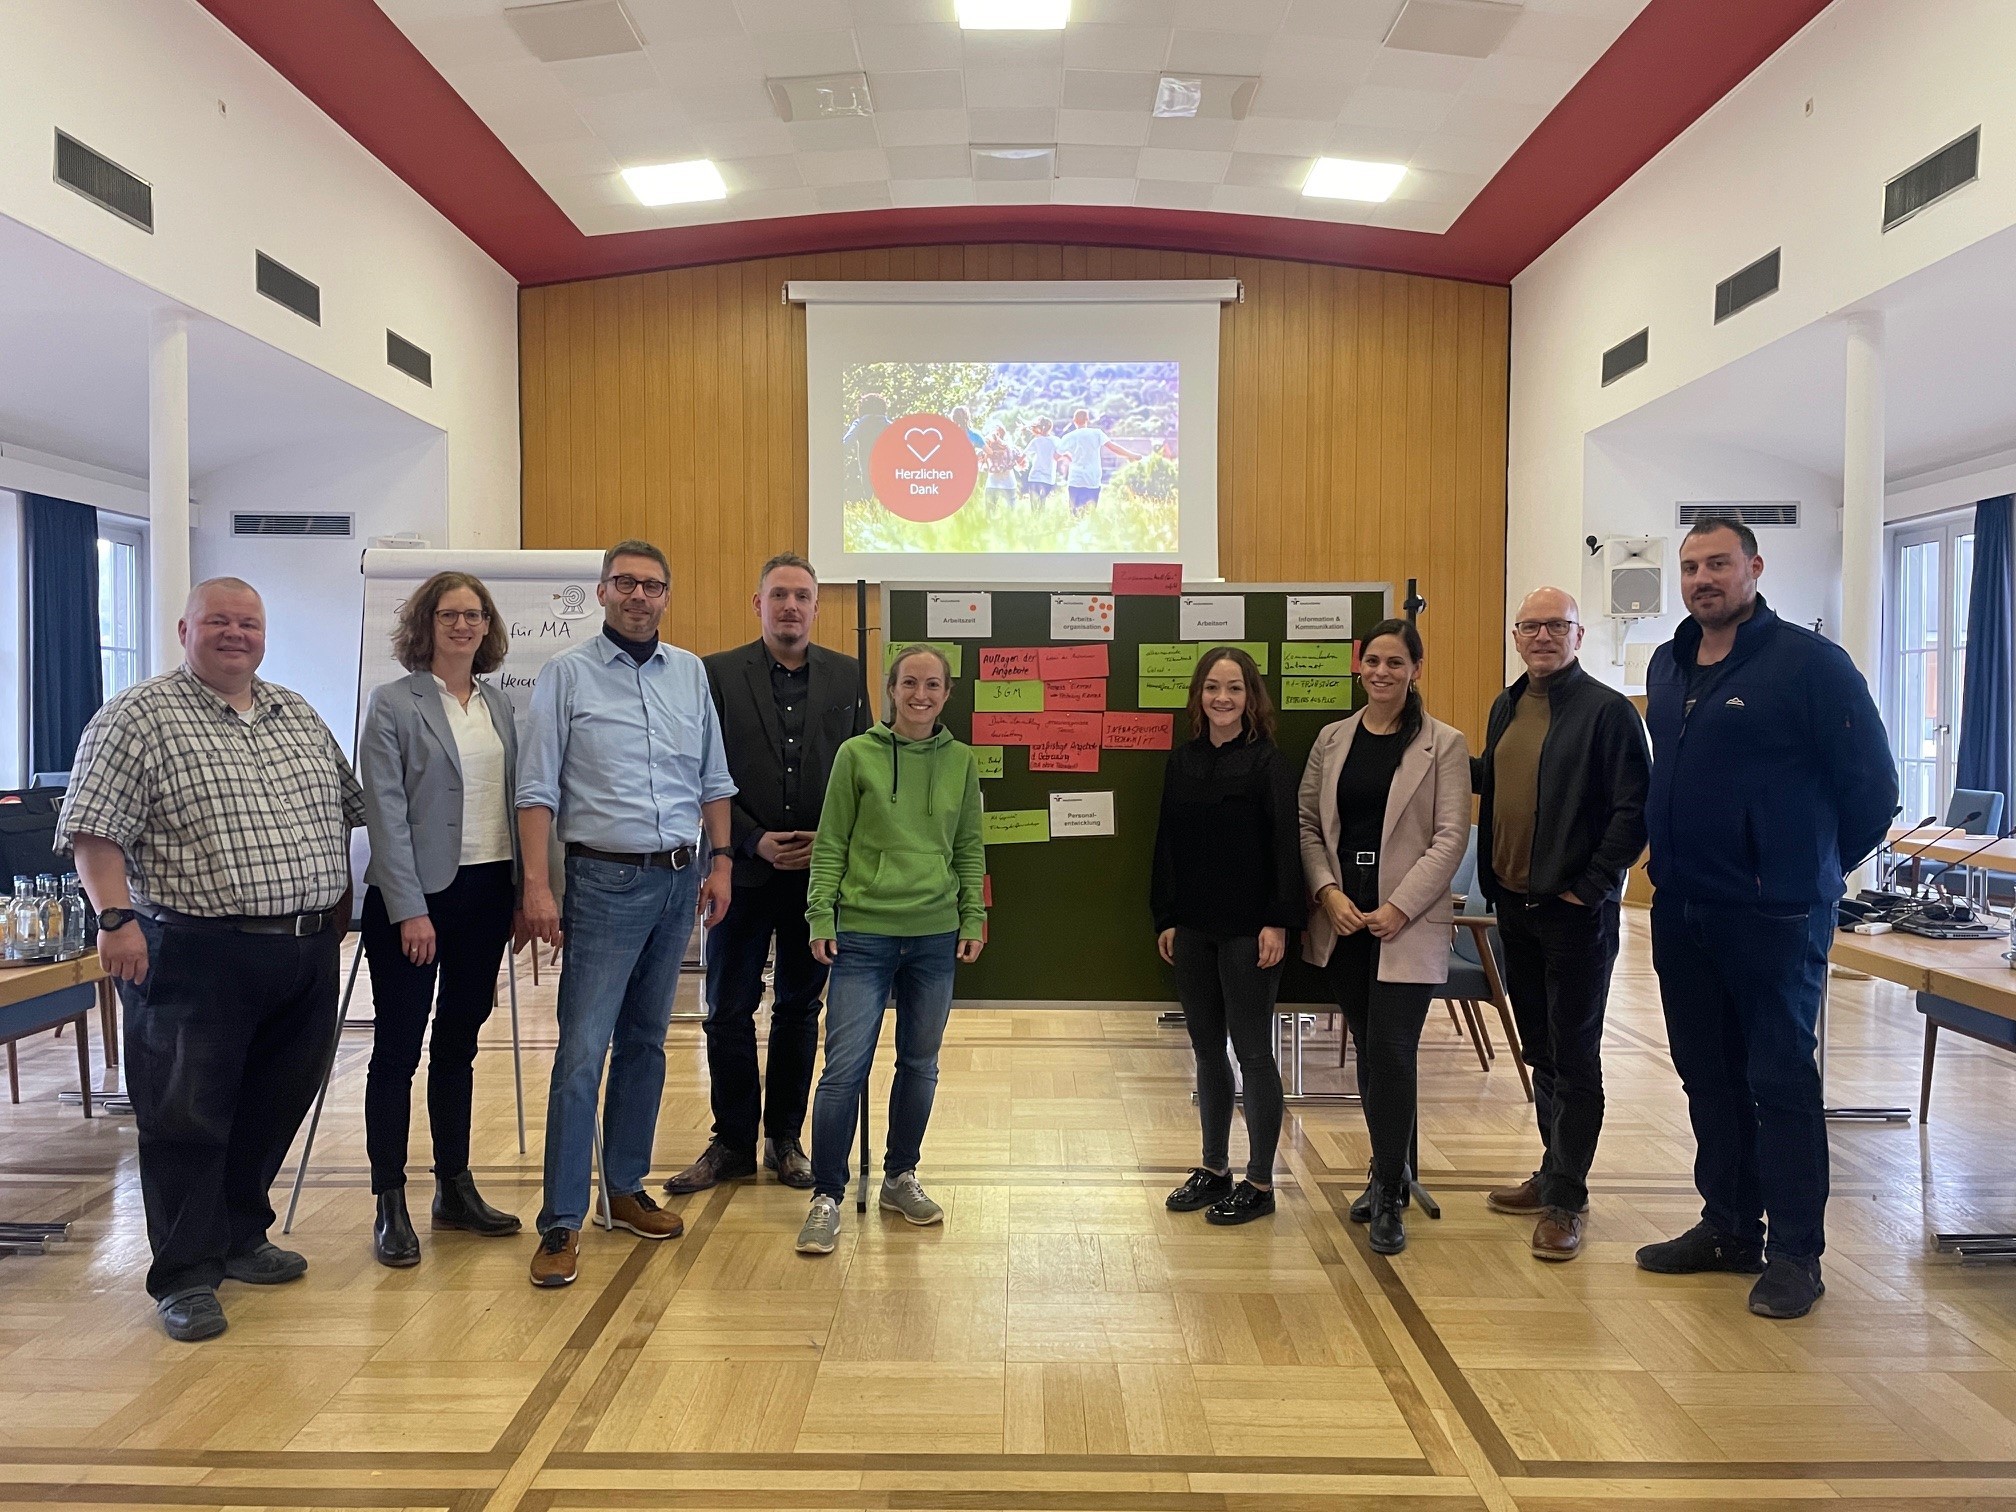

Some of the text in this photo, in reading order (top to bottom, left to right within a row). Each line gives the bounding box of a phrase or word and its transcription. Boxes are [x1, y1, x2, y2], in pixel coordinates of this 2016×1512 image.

[895, 468, 954, 480] Herzlichen
[909, 483, 939, 495] Dank
[509, 620, 571, 639] für MA
[991, 665, 1029, 679] Angebote
